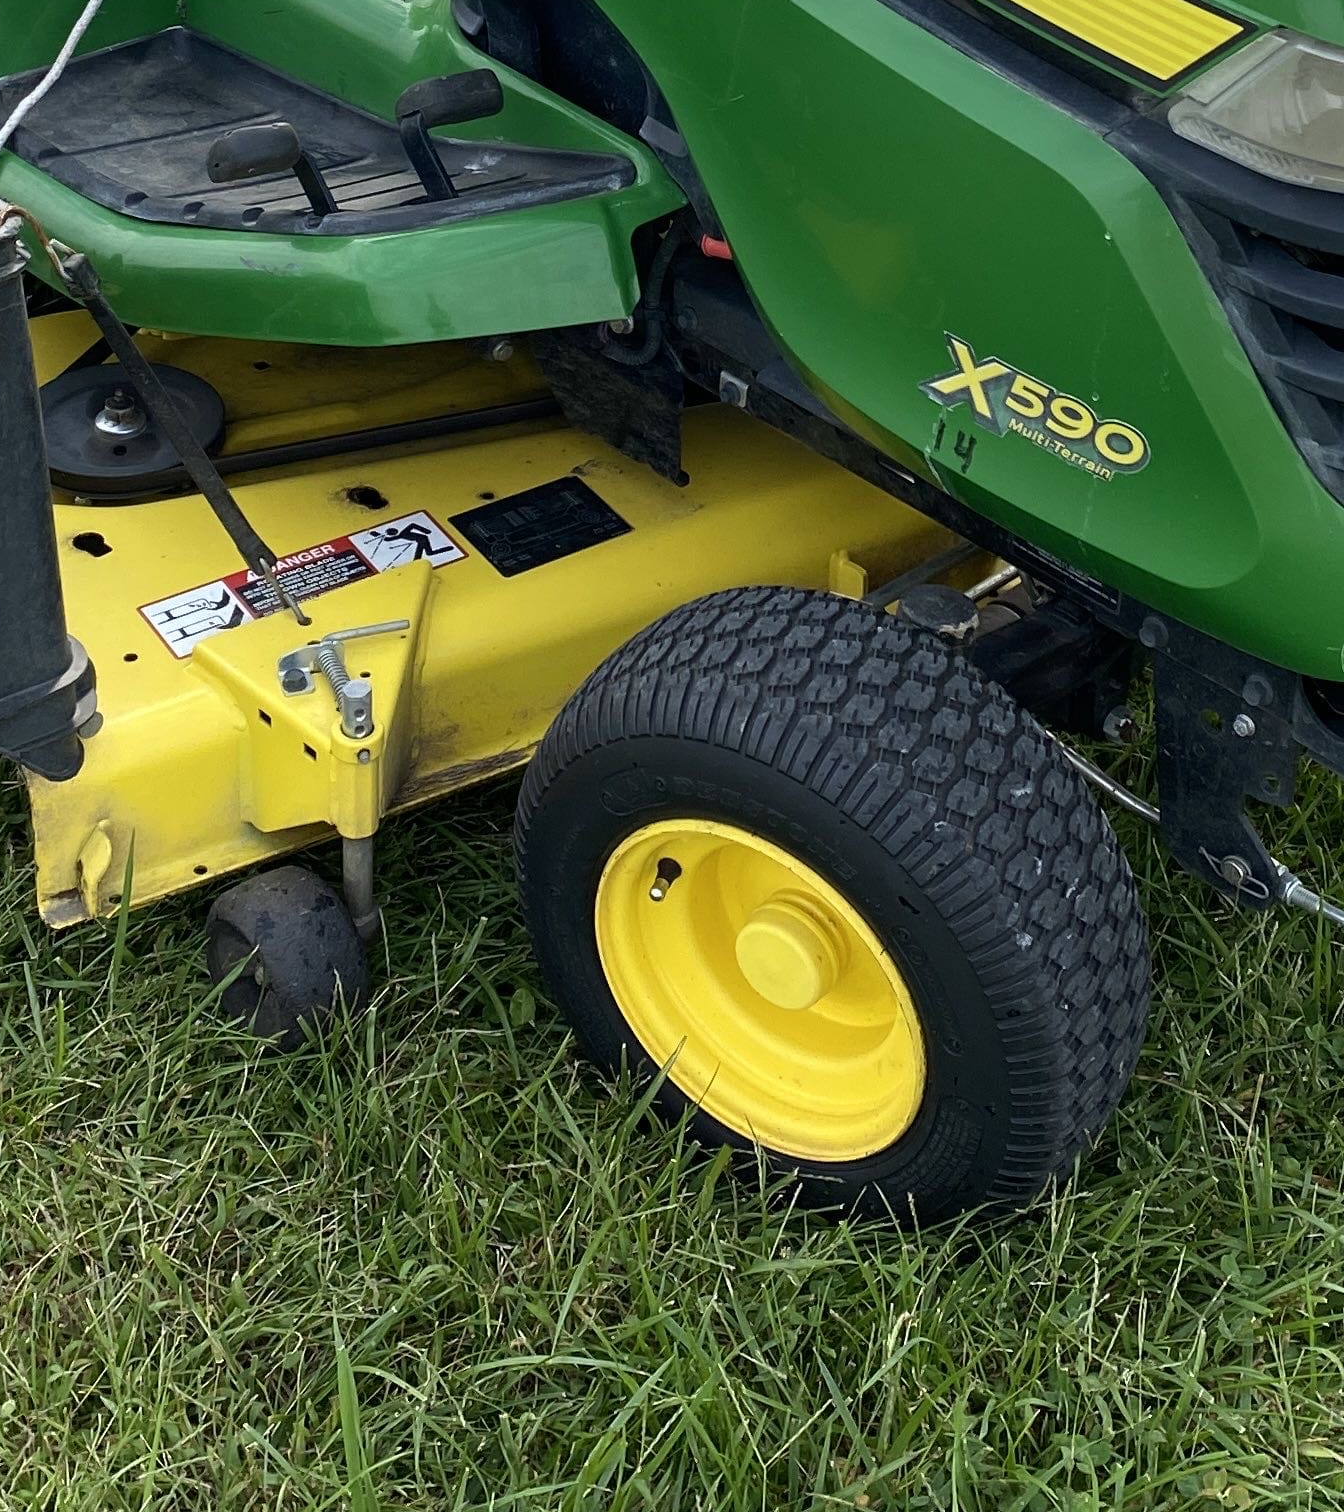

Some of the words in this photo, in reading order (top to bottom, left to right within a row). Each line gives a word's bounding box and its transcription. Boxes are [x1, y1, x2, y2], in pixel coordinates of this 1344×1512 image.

[930, 339, 1145, 465] X590
[1008, 418, 1111, 480] Multi-Terrain
[266, 582, 307, 599] THOWN
